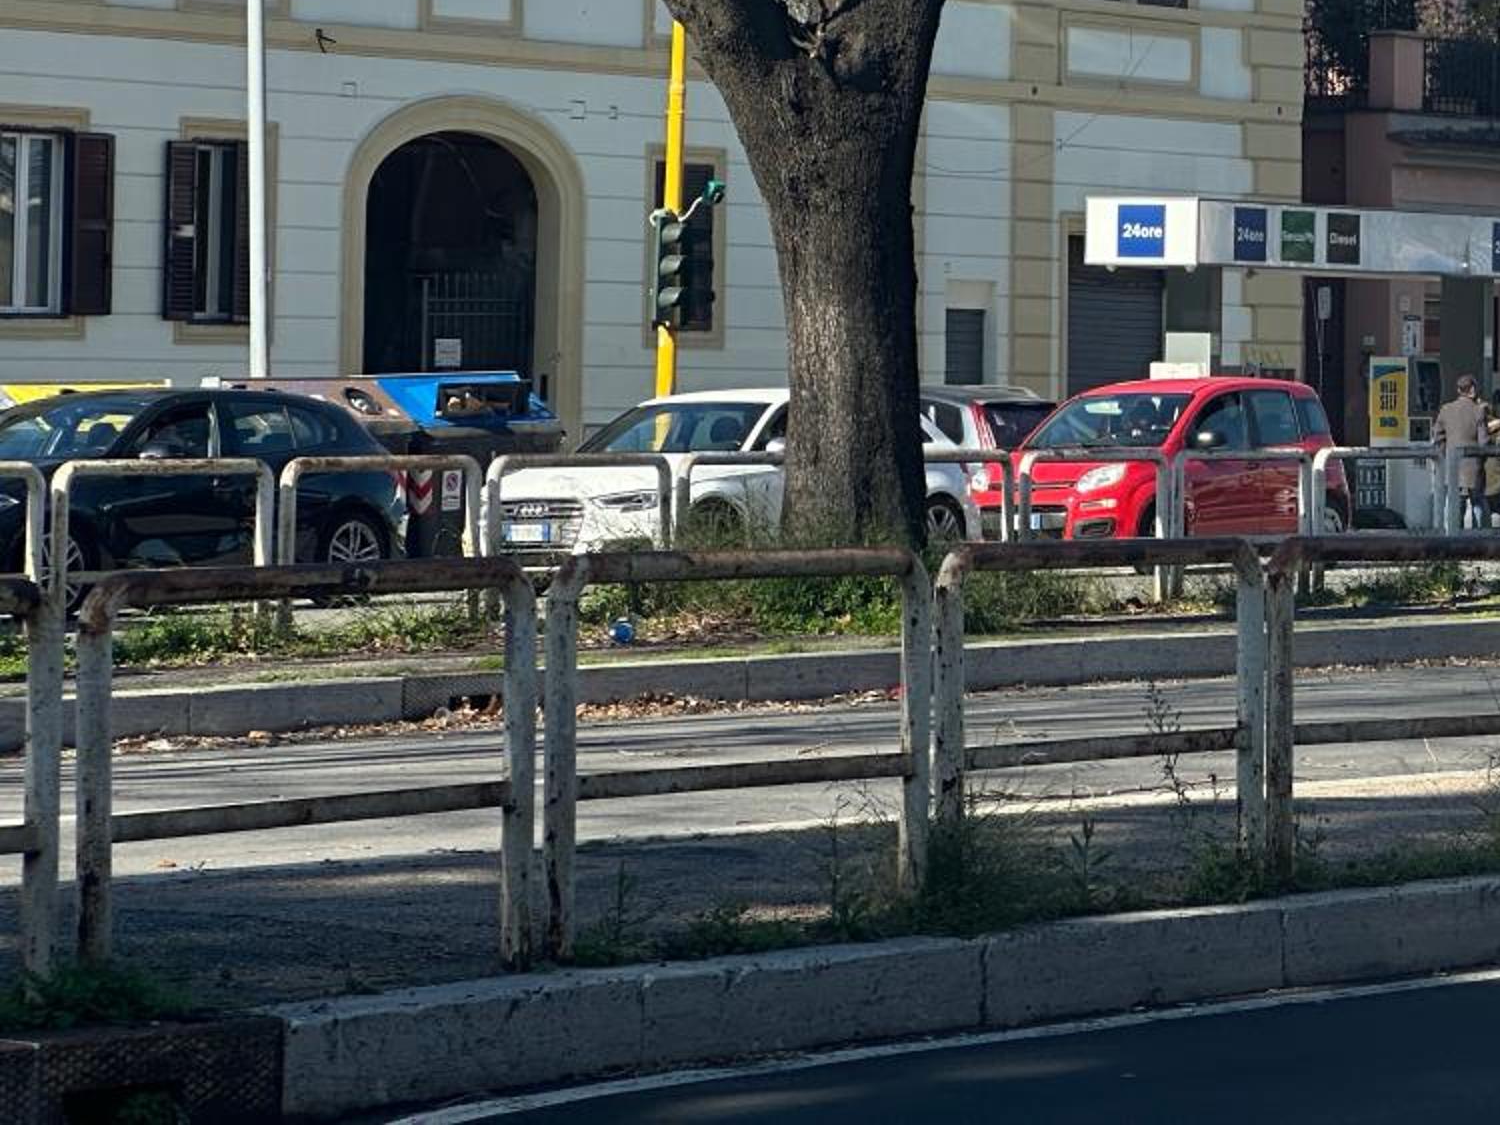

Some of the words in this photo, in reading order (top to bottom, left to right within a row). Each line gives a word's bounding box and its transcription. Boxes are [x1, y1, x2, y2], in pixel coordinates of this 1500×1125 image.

[1122, 222, 1163, 238] 24ore
[1237, 227, 1264, 242] 24ore
[1330, 232, 1357, 245] Diesel
